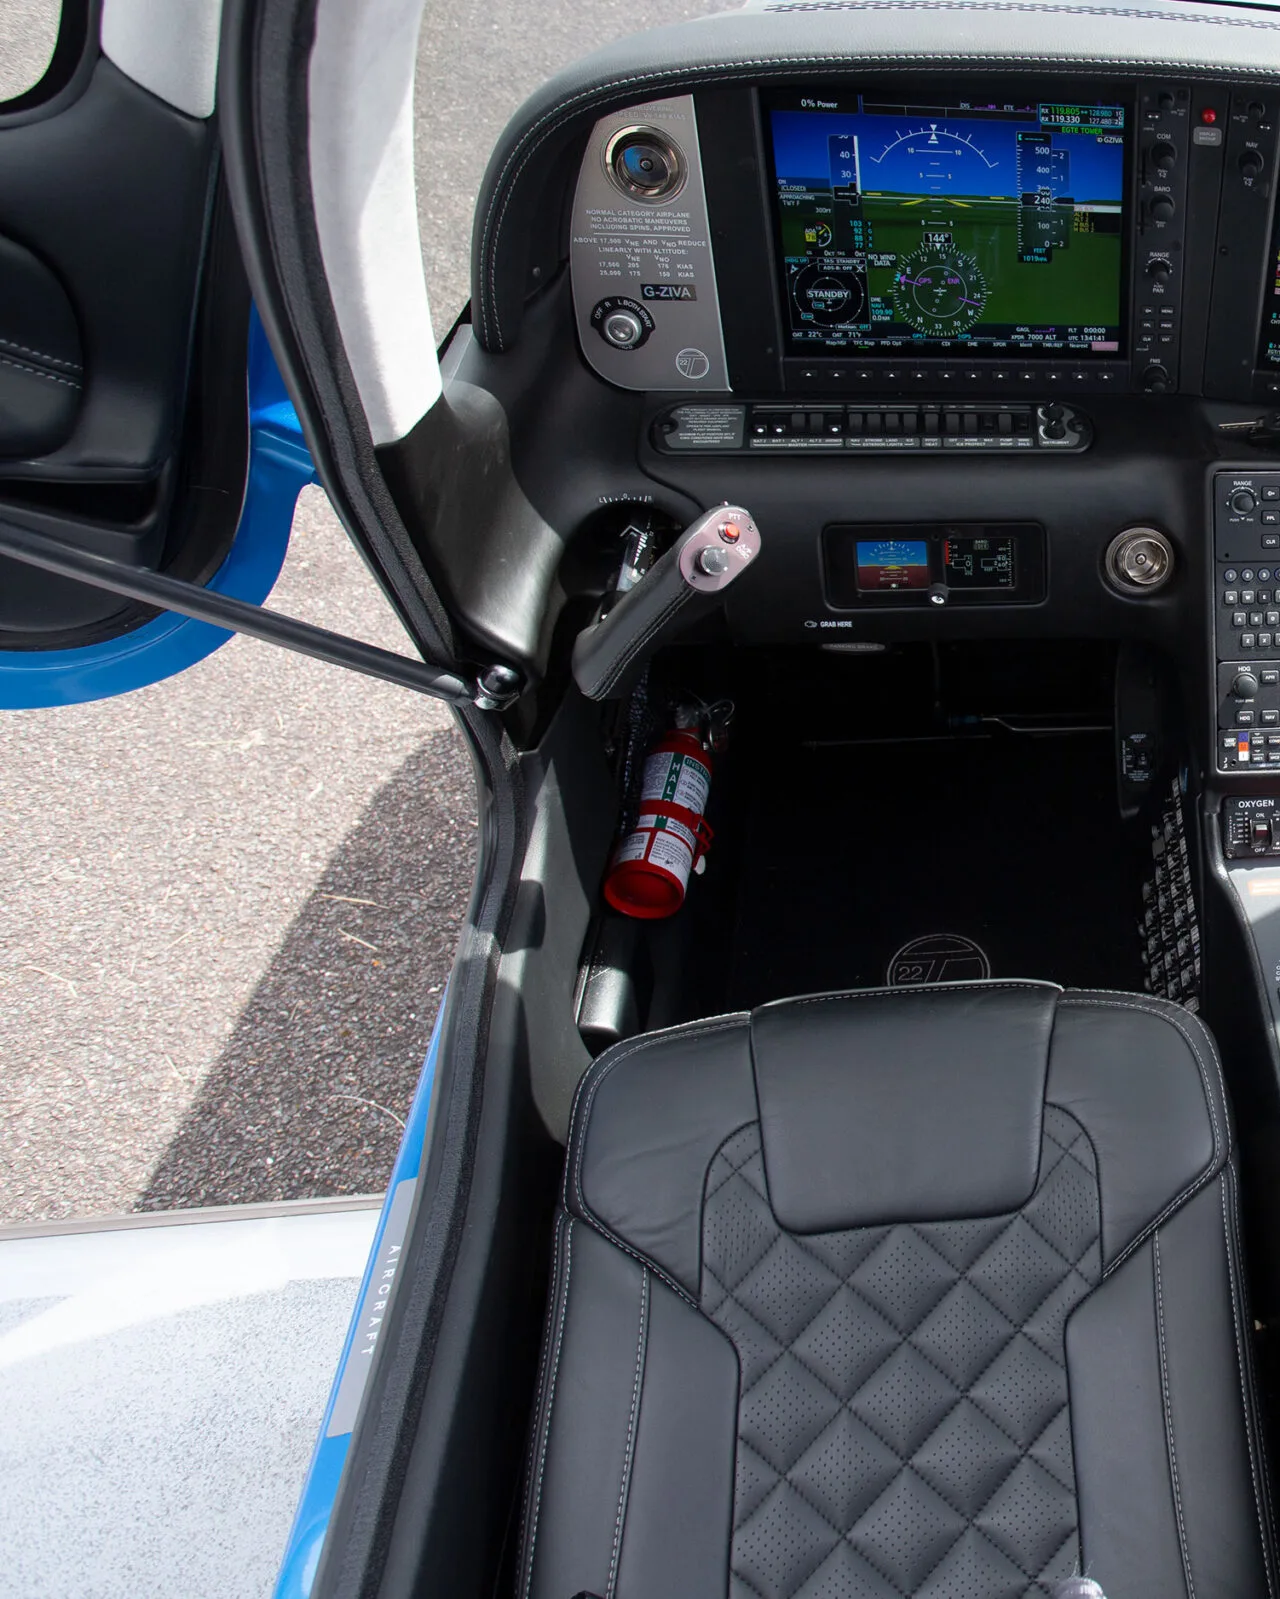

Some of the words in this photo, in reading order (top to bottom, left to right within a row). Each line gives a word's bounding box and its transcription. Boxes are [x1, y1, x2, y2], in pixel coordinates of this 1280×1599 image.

[801, 99, 816, 108] 0%
[817, 101, 838, 109] Power
[1050, 106, 1080, 116] 119.805
[1050, 115, 1080, 124] 119.330
[840, 151, 850, 159] 40
[1035, 147, 1050, 155] 500
[1038, 222, 1050, 230] 100
[927, 234, 949, 243] 144°
[643, 286, 692, 297] G-ZIVA
[807, 290, 849, 299] STANDBY
[623, 300, 640, 312] BOTH
[1238, 800, 1274, 808] OXYGEN
[898, 966, 923, 980] 22
[361, 1244, 402, 1355] AIRCRAFT
